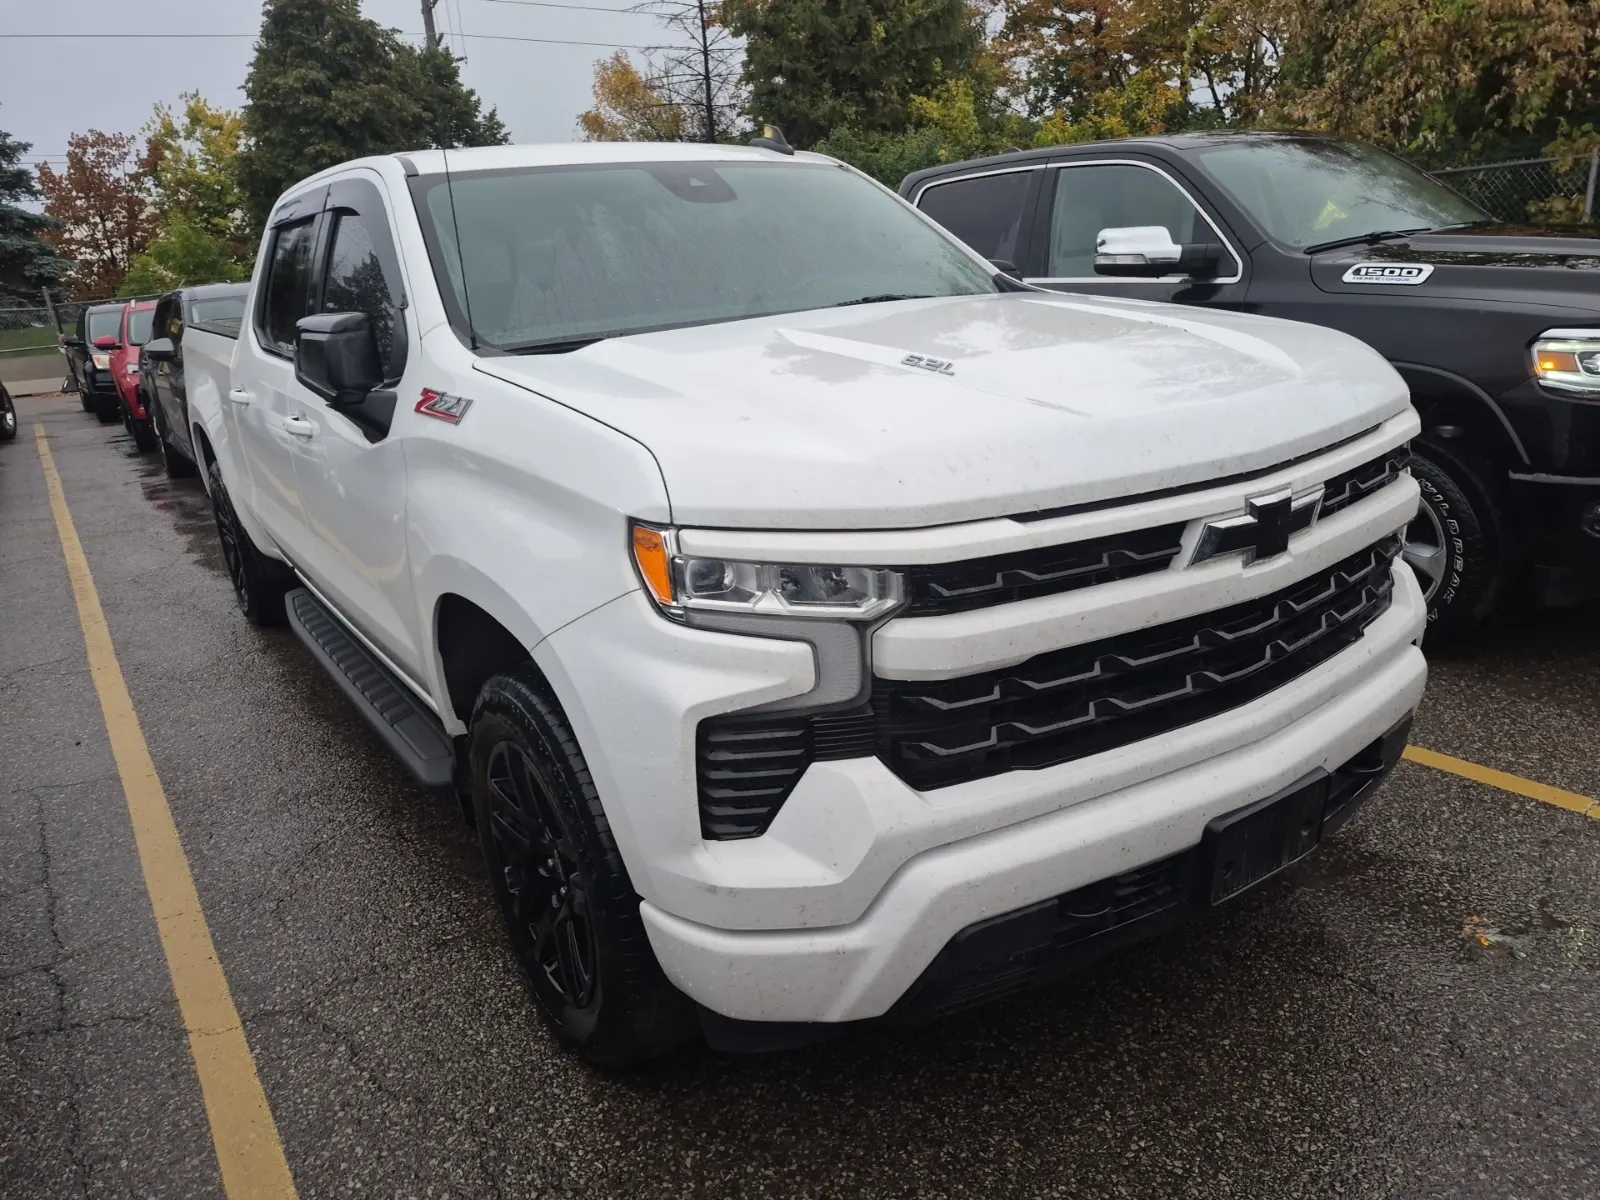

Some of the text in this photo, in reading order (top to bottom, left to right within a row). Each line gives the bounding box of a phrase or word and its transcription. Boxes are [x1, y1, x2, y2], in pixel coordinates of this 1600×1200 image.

[1359, 267, 1420, 277] 1500
[413, 387, 473, 426] Z71
[1417, 477, 1464, 604] WILDPEAK
